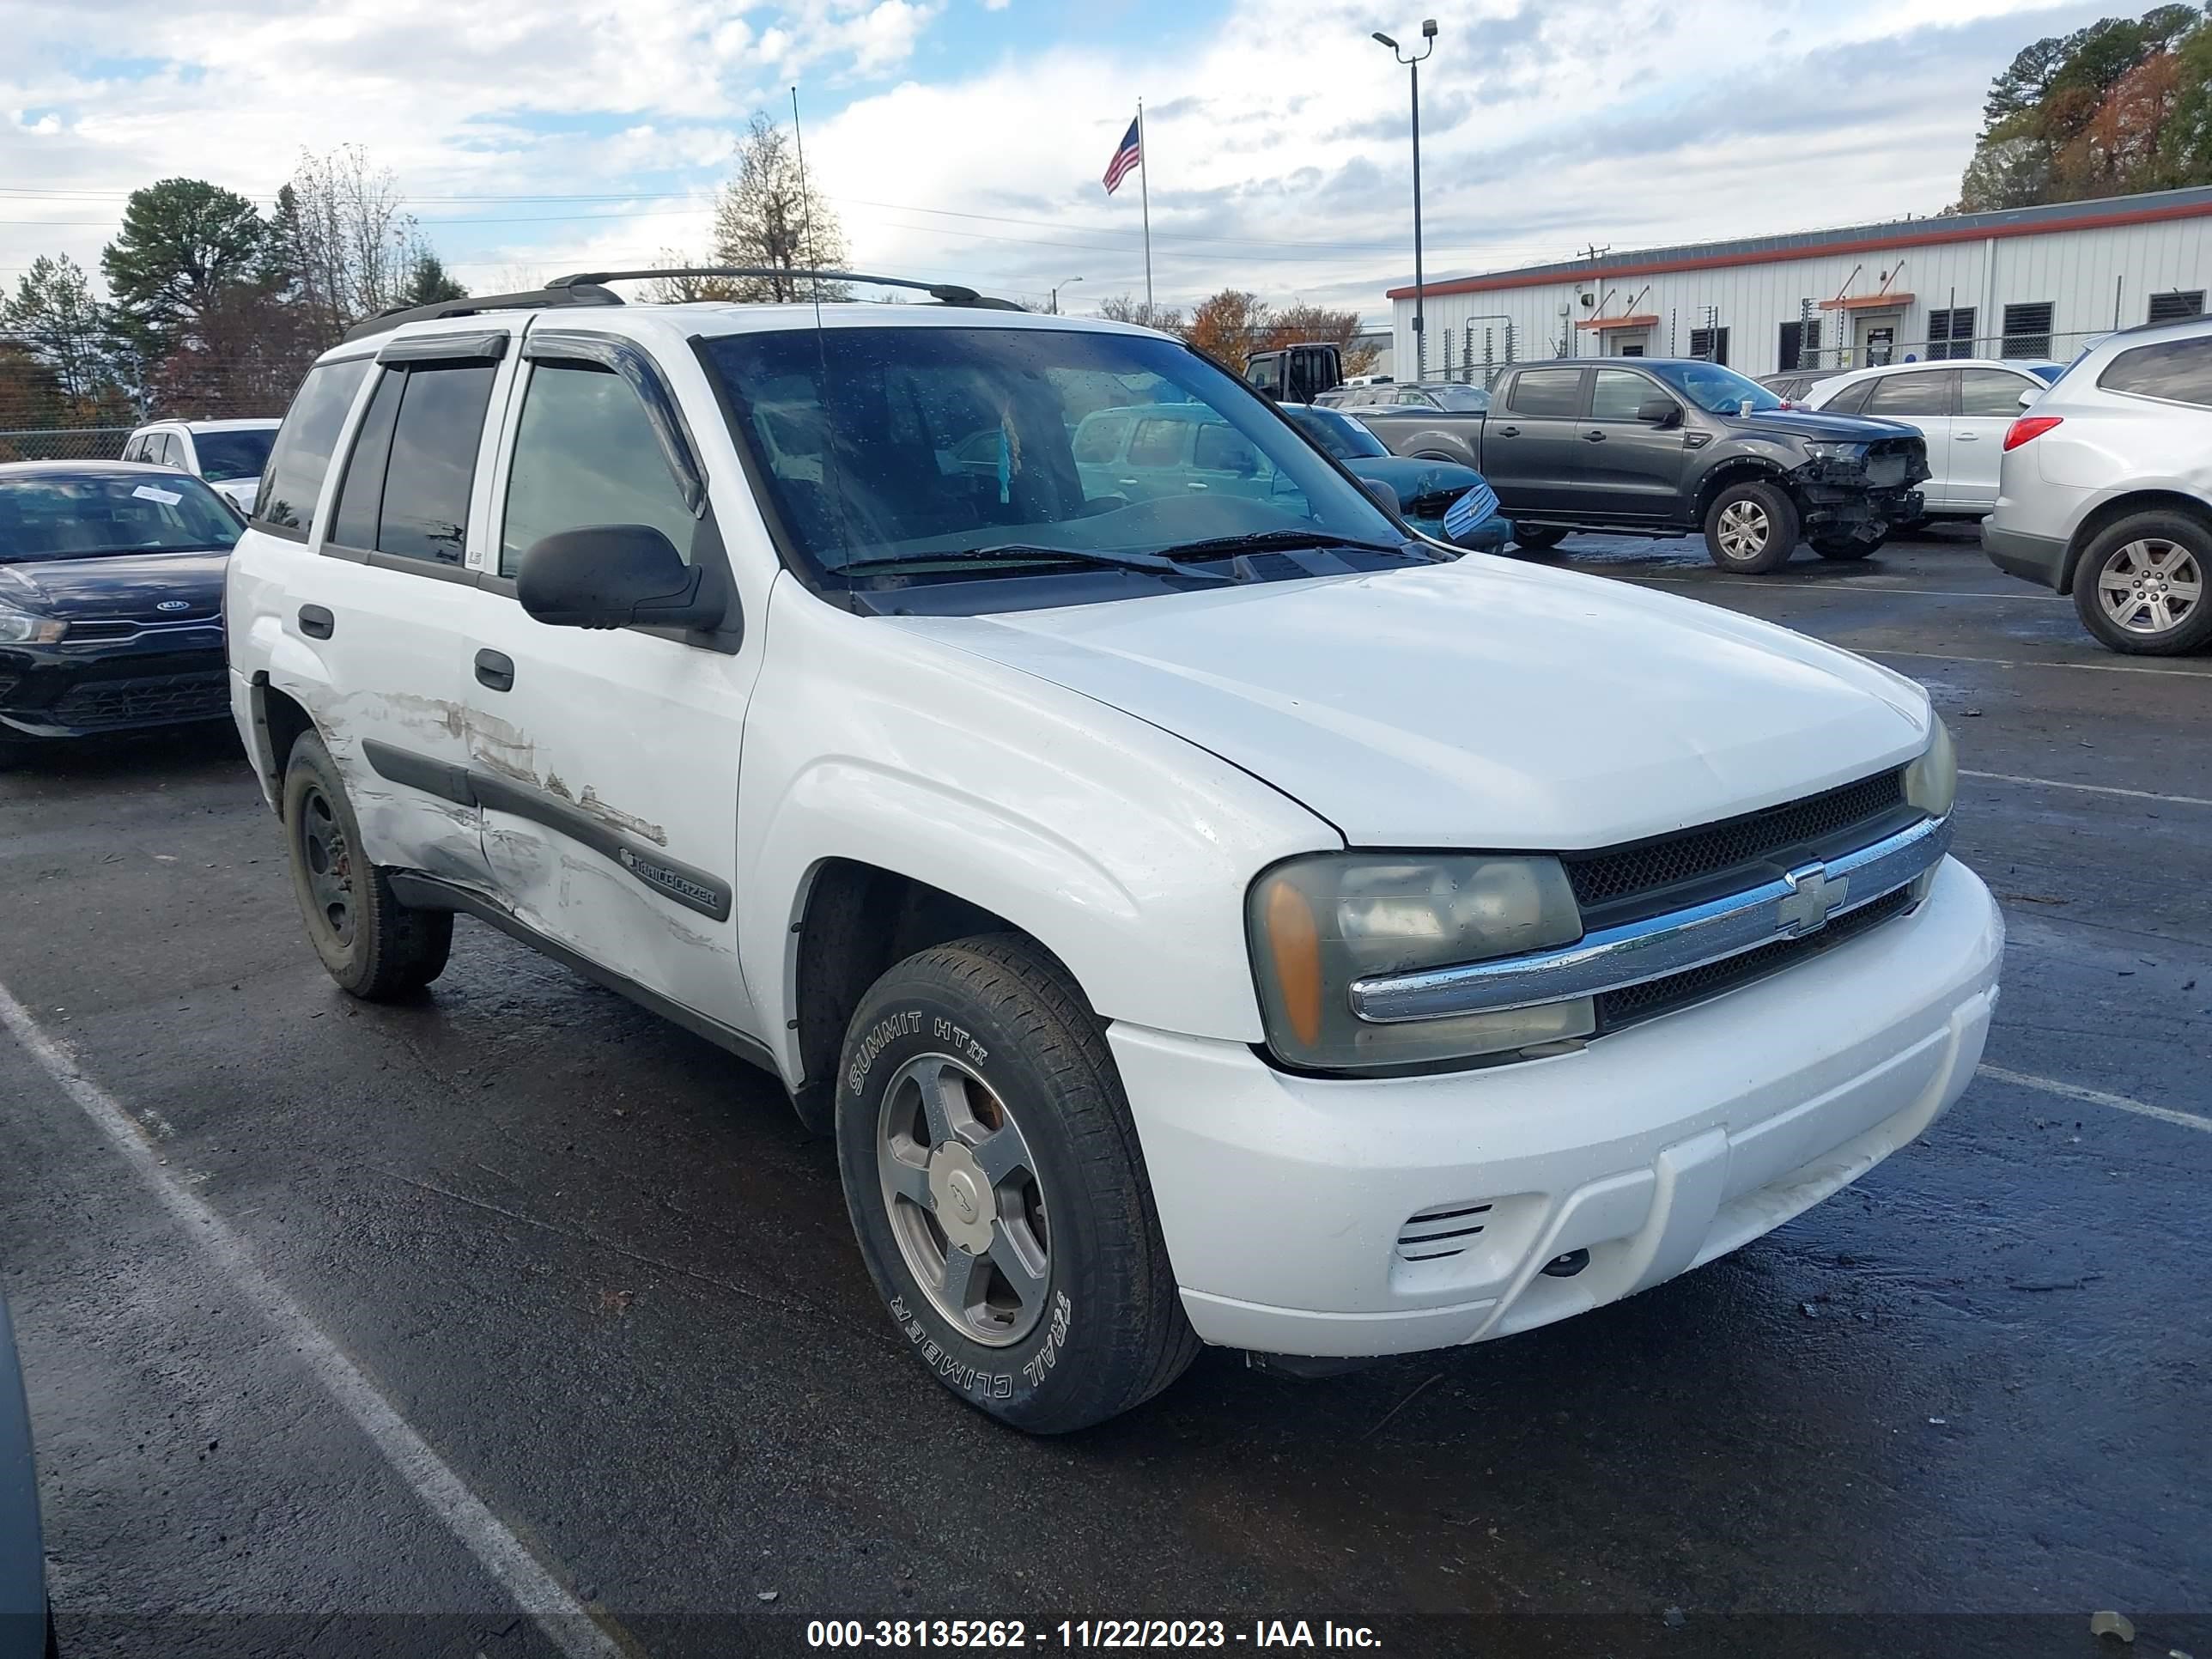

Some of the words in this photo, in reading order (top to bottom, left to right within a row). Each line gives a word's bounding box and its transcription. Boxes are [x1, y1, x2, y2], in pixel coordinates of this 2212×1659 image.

[848, 1011, 923, 1096] SUMMIT
[890, 1295, 1013, 1399] CLIMBER
[1023, 1290, 1072, 1387] TRAIL
